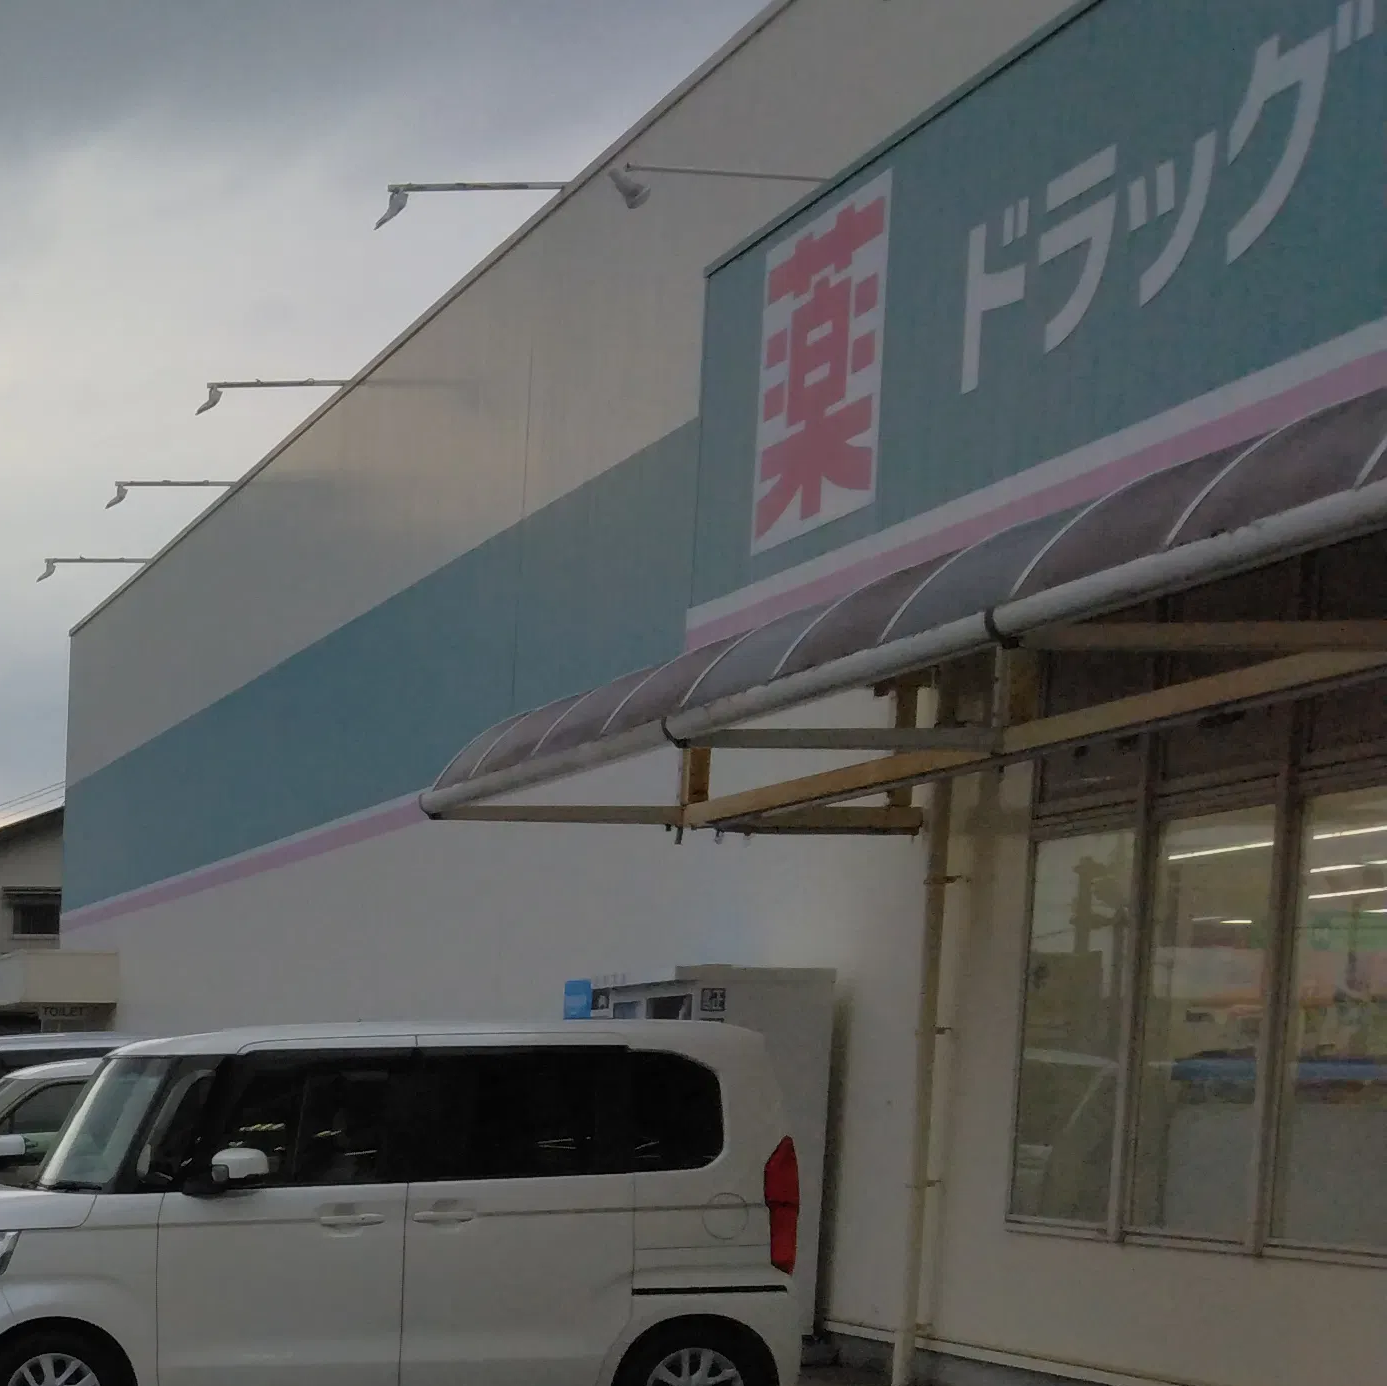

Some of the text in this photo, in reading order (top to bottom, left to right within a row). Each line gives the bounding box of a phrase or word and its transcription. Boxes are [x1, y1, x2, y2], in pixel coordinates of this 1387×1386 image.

[756, 196, 885, 540] 薬
[960, 0, 1375, 395] ドラッグ
[43, 1006, 85, 1017] TOILET
